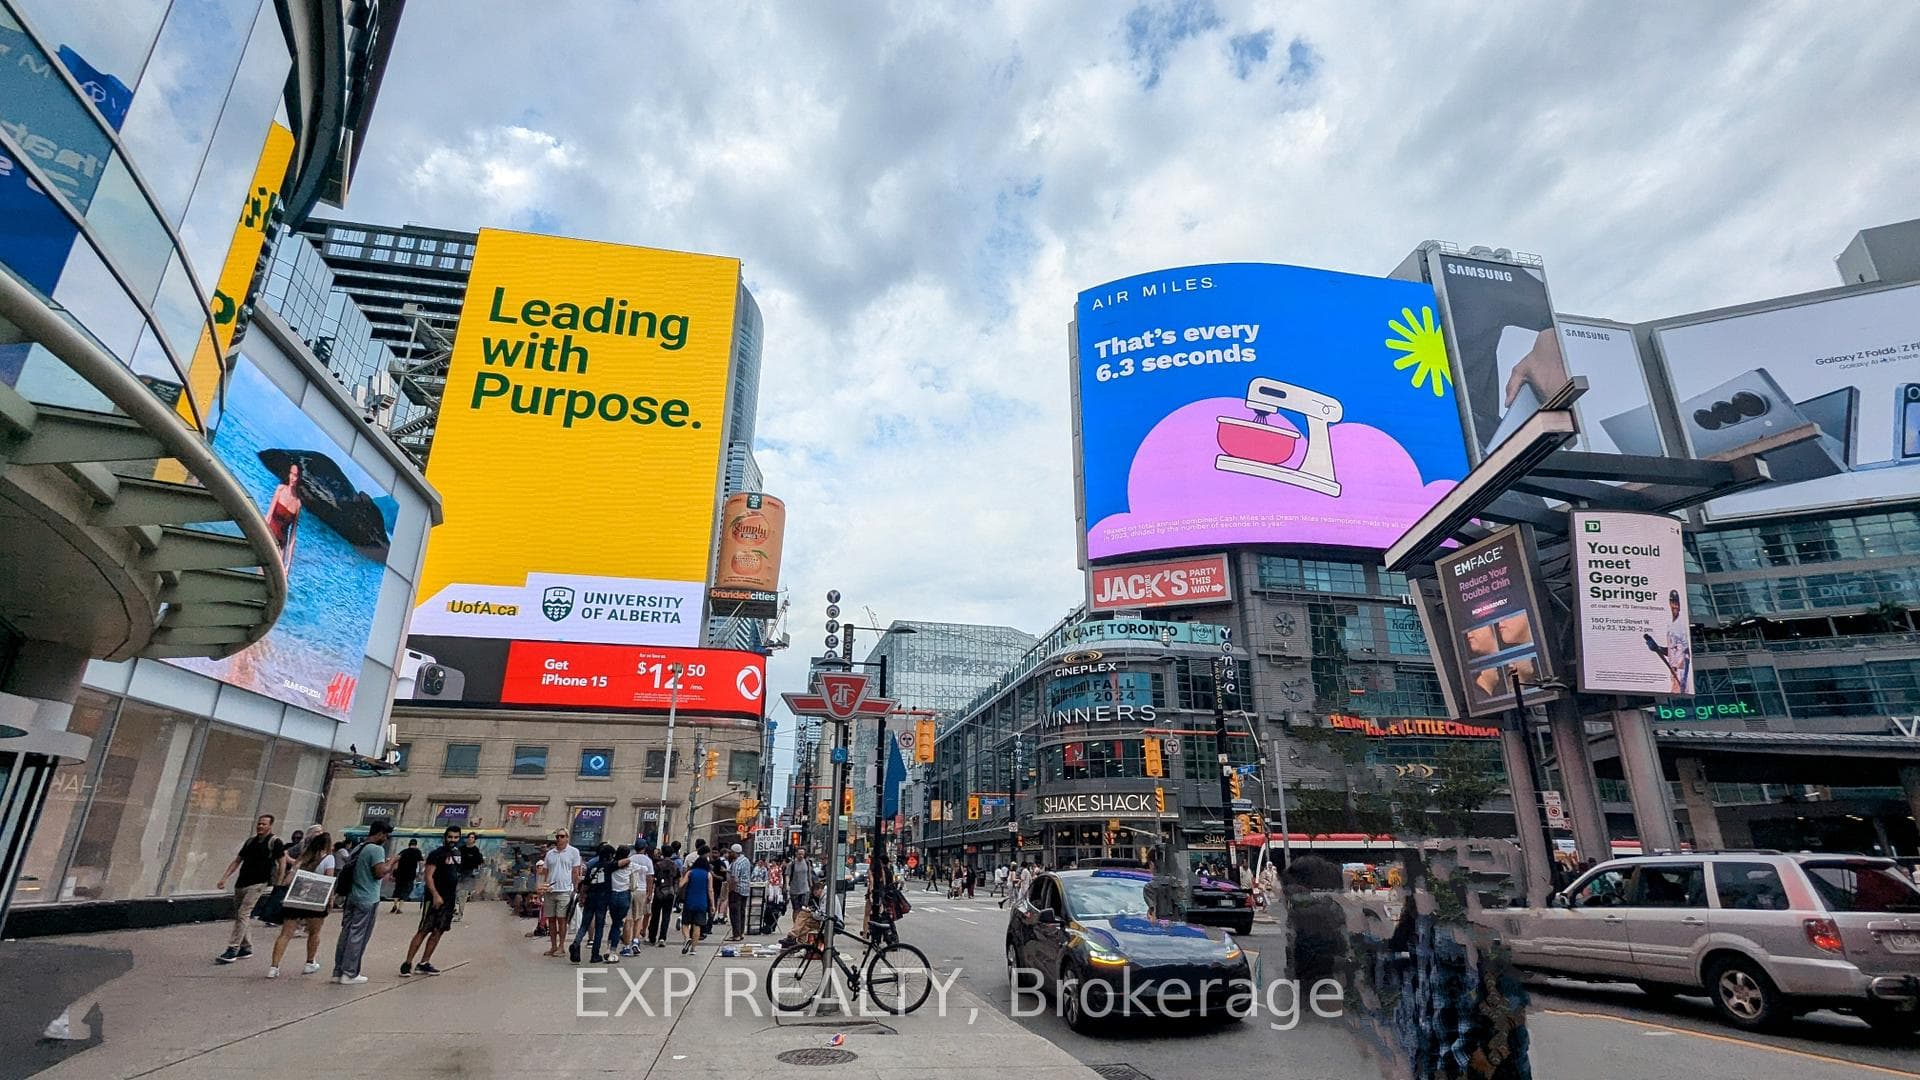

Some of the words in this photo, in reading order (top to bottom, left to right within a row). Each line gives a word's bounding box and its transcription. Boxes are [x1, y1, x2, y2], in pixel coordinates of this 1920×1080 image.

[1447, 263, 1513, 282] SAMSUNG
[1092, 291, 1128, 310] AIR
[1142, 277, 1214, 297] MILES
[489, 286, 690, 351] Leading
[1094, 328, 1176, 359] That's
[1183, 324, 1260, 343] every
[1565, 328, 1611, 342] SAMSUNG
[483, 331, 588, 374] with
[1815, 354, 1855, 366] Galaxy
[1865, 347, 1897, 358] Fold6
[1902, 344, 1910, 352] Z
[1096, 358, 1135, 382] 6.3
[1141, 344, 1257, 372] seconds
[470, 371, 702, 428] Purpose.
[733, 522, 768, 539] Simply
[1586, 522, 1600, 531] TD
[1587, 541, 1618, 555] You
[1622, 544, 1660, 557] could
[1454, 547, 1502, 577] EMFACE
[1588, 558, 1631, 570] meet
[1189, 567, 1217, 577] PARTY
[1459, 574, 1488, 592] Reduce
[1488, 565, 1508, 579] Your
[1589, 571, 1649, 587] George
[1096, 569, 1189, 603] JACK'S
[1190, 576, 1211, 585] THIS
[711, 590, 776, 601] brandedcities
[1191, 584, 1211, 594] WAY
[1461, 585, 1490, 602] Double
[1491, 577, 1511, 592] Chin
[1590, 586, 1658, 602] Springer
[450, 599, 517, 617] UofA.ca
[583, 591, 684, 609] UNIVERSITY
[581, 607, 603, 620] OF
[608, 608, 681, 624] ALBERTA
[1073, 625, 1104, 639] CAFE
[1107, 623, 1178, 636] TORONTO
[544, 658, 569, 671] Get
[687, 664, 706, 677] 50
[1055, 662, 1117, 677] CINEPLEX
[541, 673, 588, 687] iPhone
[590, 675, 608, 688] 15
[1093, 679, 1135, 690] FALL
[1213, 661, 1223, 710] DOWNTOWN
[1094, 691, 1136, 703] 2024
[1039, 704, 1157, 730] WINNERS
[1659, 704, 1686, 719] be
[1695, 701, 1756, 720] great.
[367, 806, 387, 815] fido
[1044, 794, 1087, 813] SHAKE
[1090, 794, 1152, 812] SHACK
[756, 829, 782, 837] FREE
[755, 840, 783, 850] ISLAM
